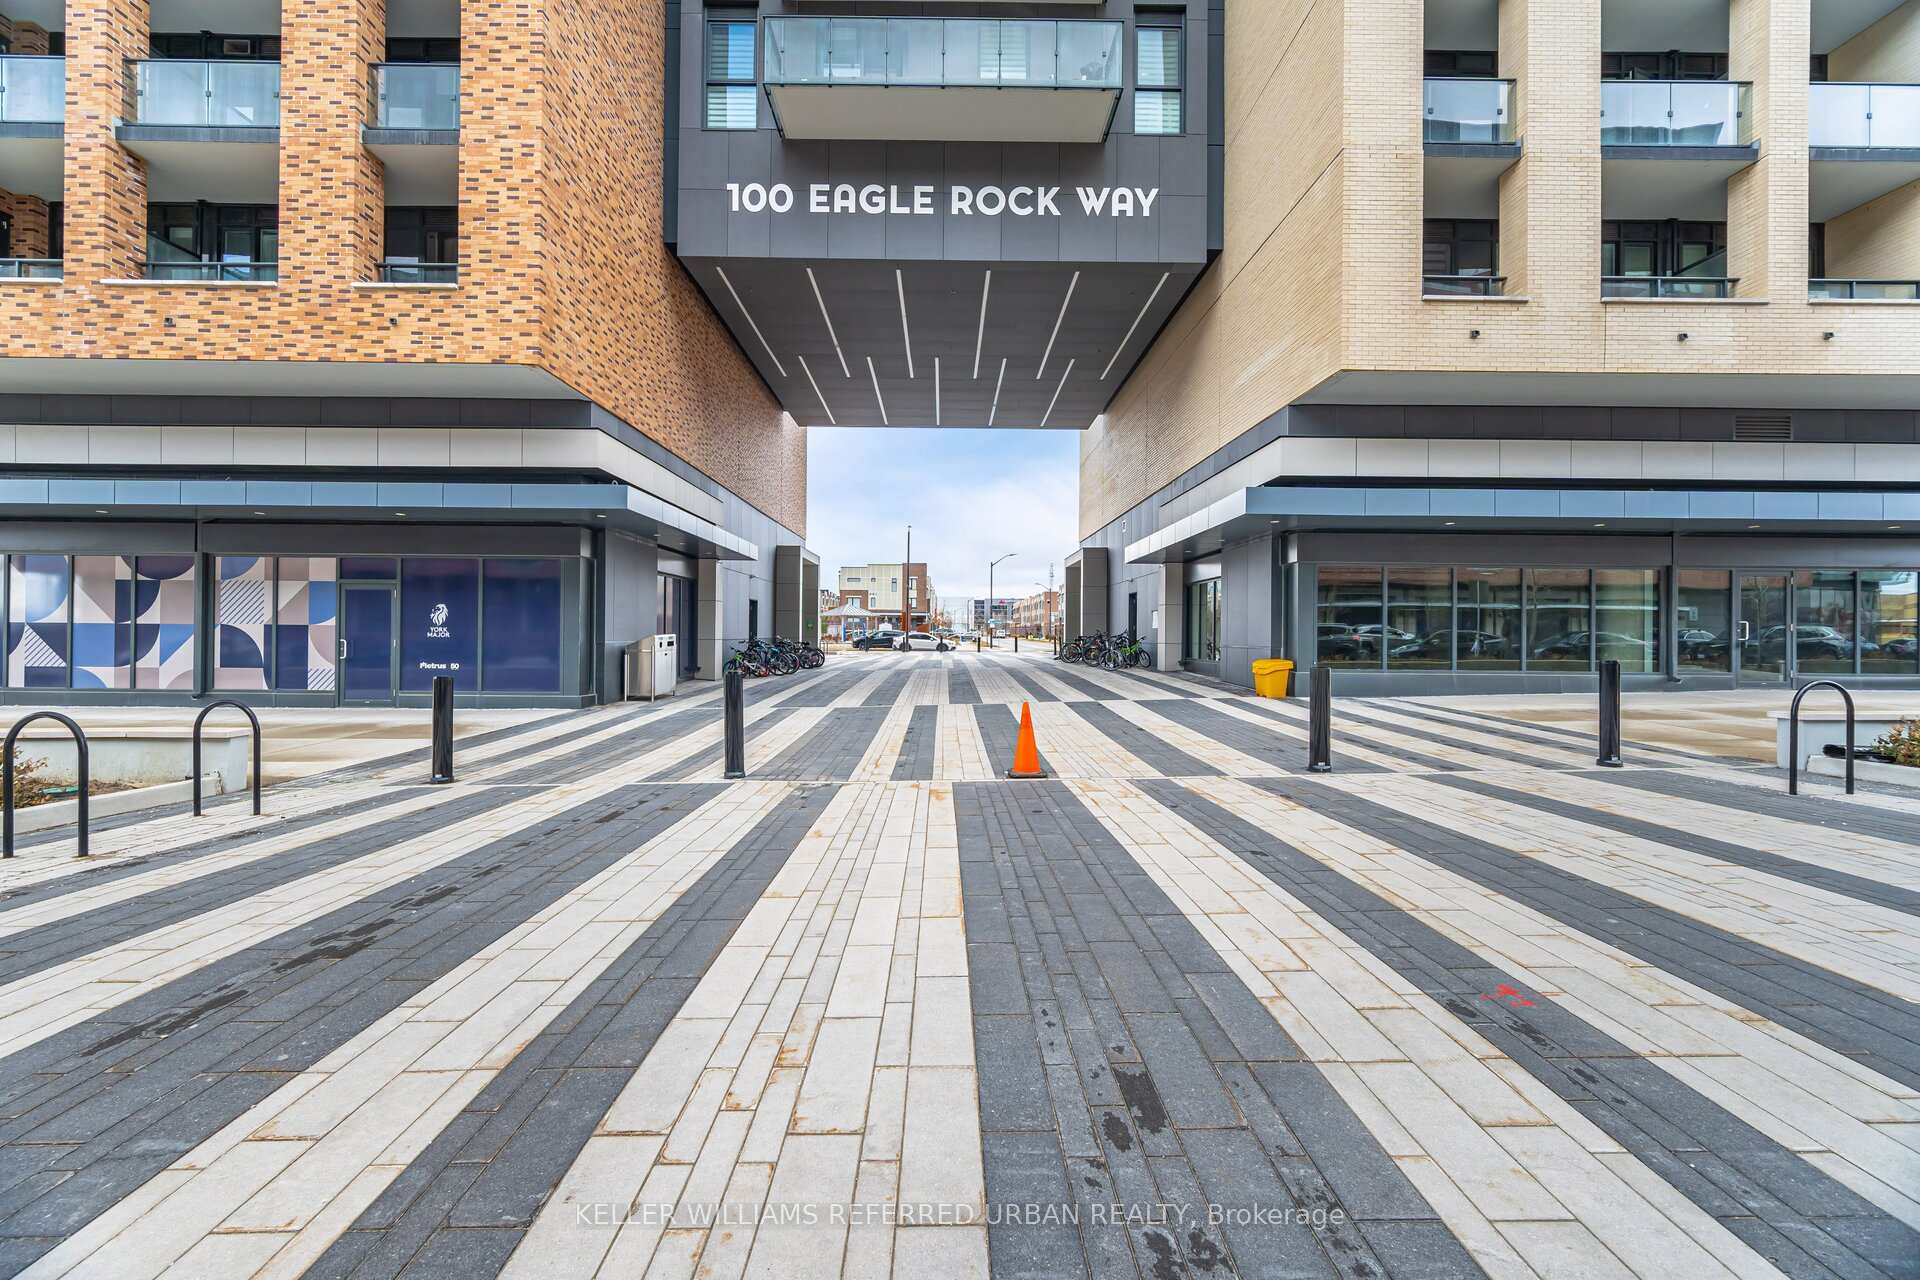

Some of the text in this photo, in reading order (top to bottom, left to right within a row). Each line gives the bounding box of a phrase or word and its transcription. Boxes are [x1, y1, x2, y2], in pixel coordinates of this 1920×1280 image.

[726, 183, 1159, 217] 100 EAGLE ROCK WAY
